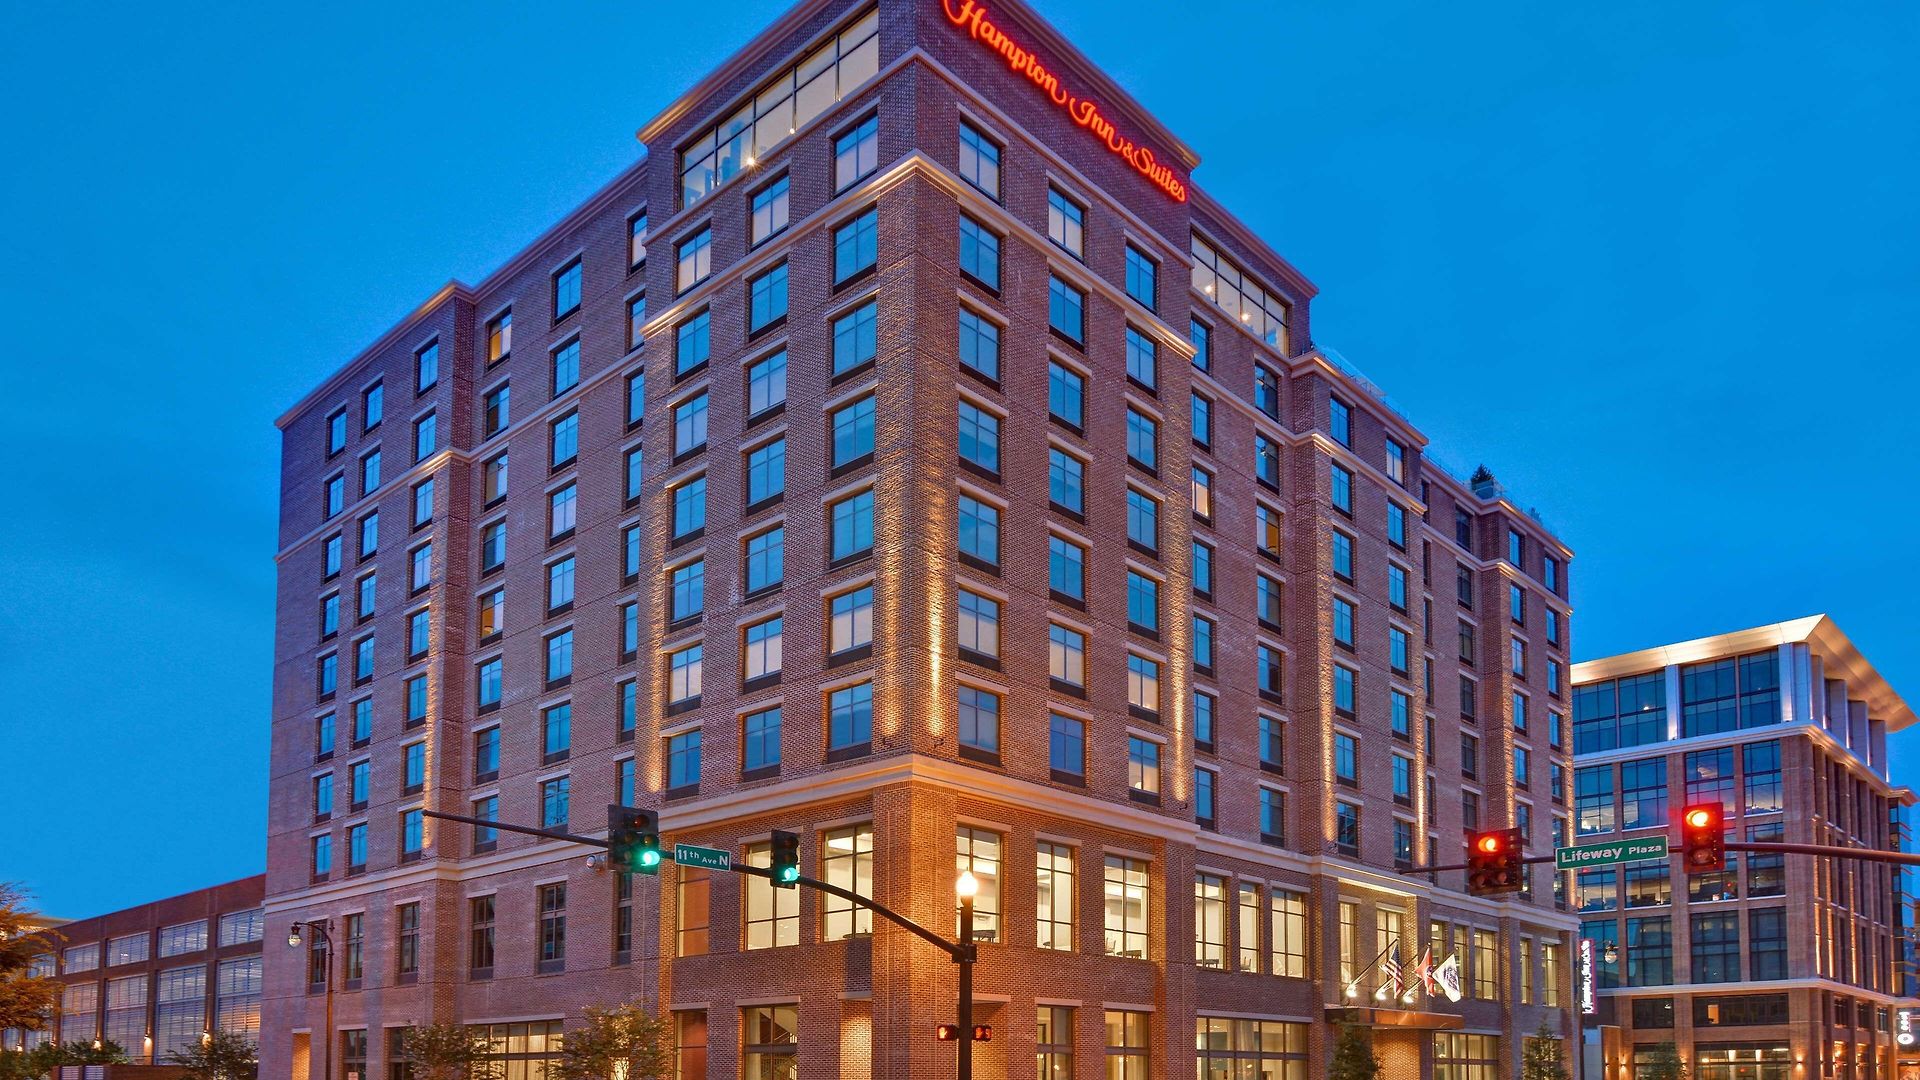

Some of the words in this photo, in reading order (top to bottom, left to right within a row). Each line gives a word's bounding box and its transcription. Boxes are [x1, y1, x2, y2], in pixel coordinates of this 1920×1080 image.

[943, 0, 1067, 104] Hampton
[1069, 98, 1124, 151] Inn
[677, 849, 700, 861] 11th
[702, 856, 717, 865] Ave
[719, 855, 728, 866] N
[1561, 847, 1623, 863] Lifeway
[1628, 845, 1662, 855] Plaza
